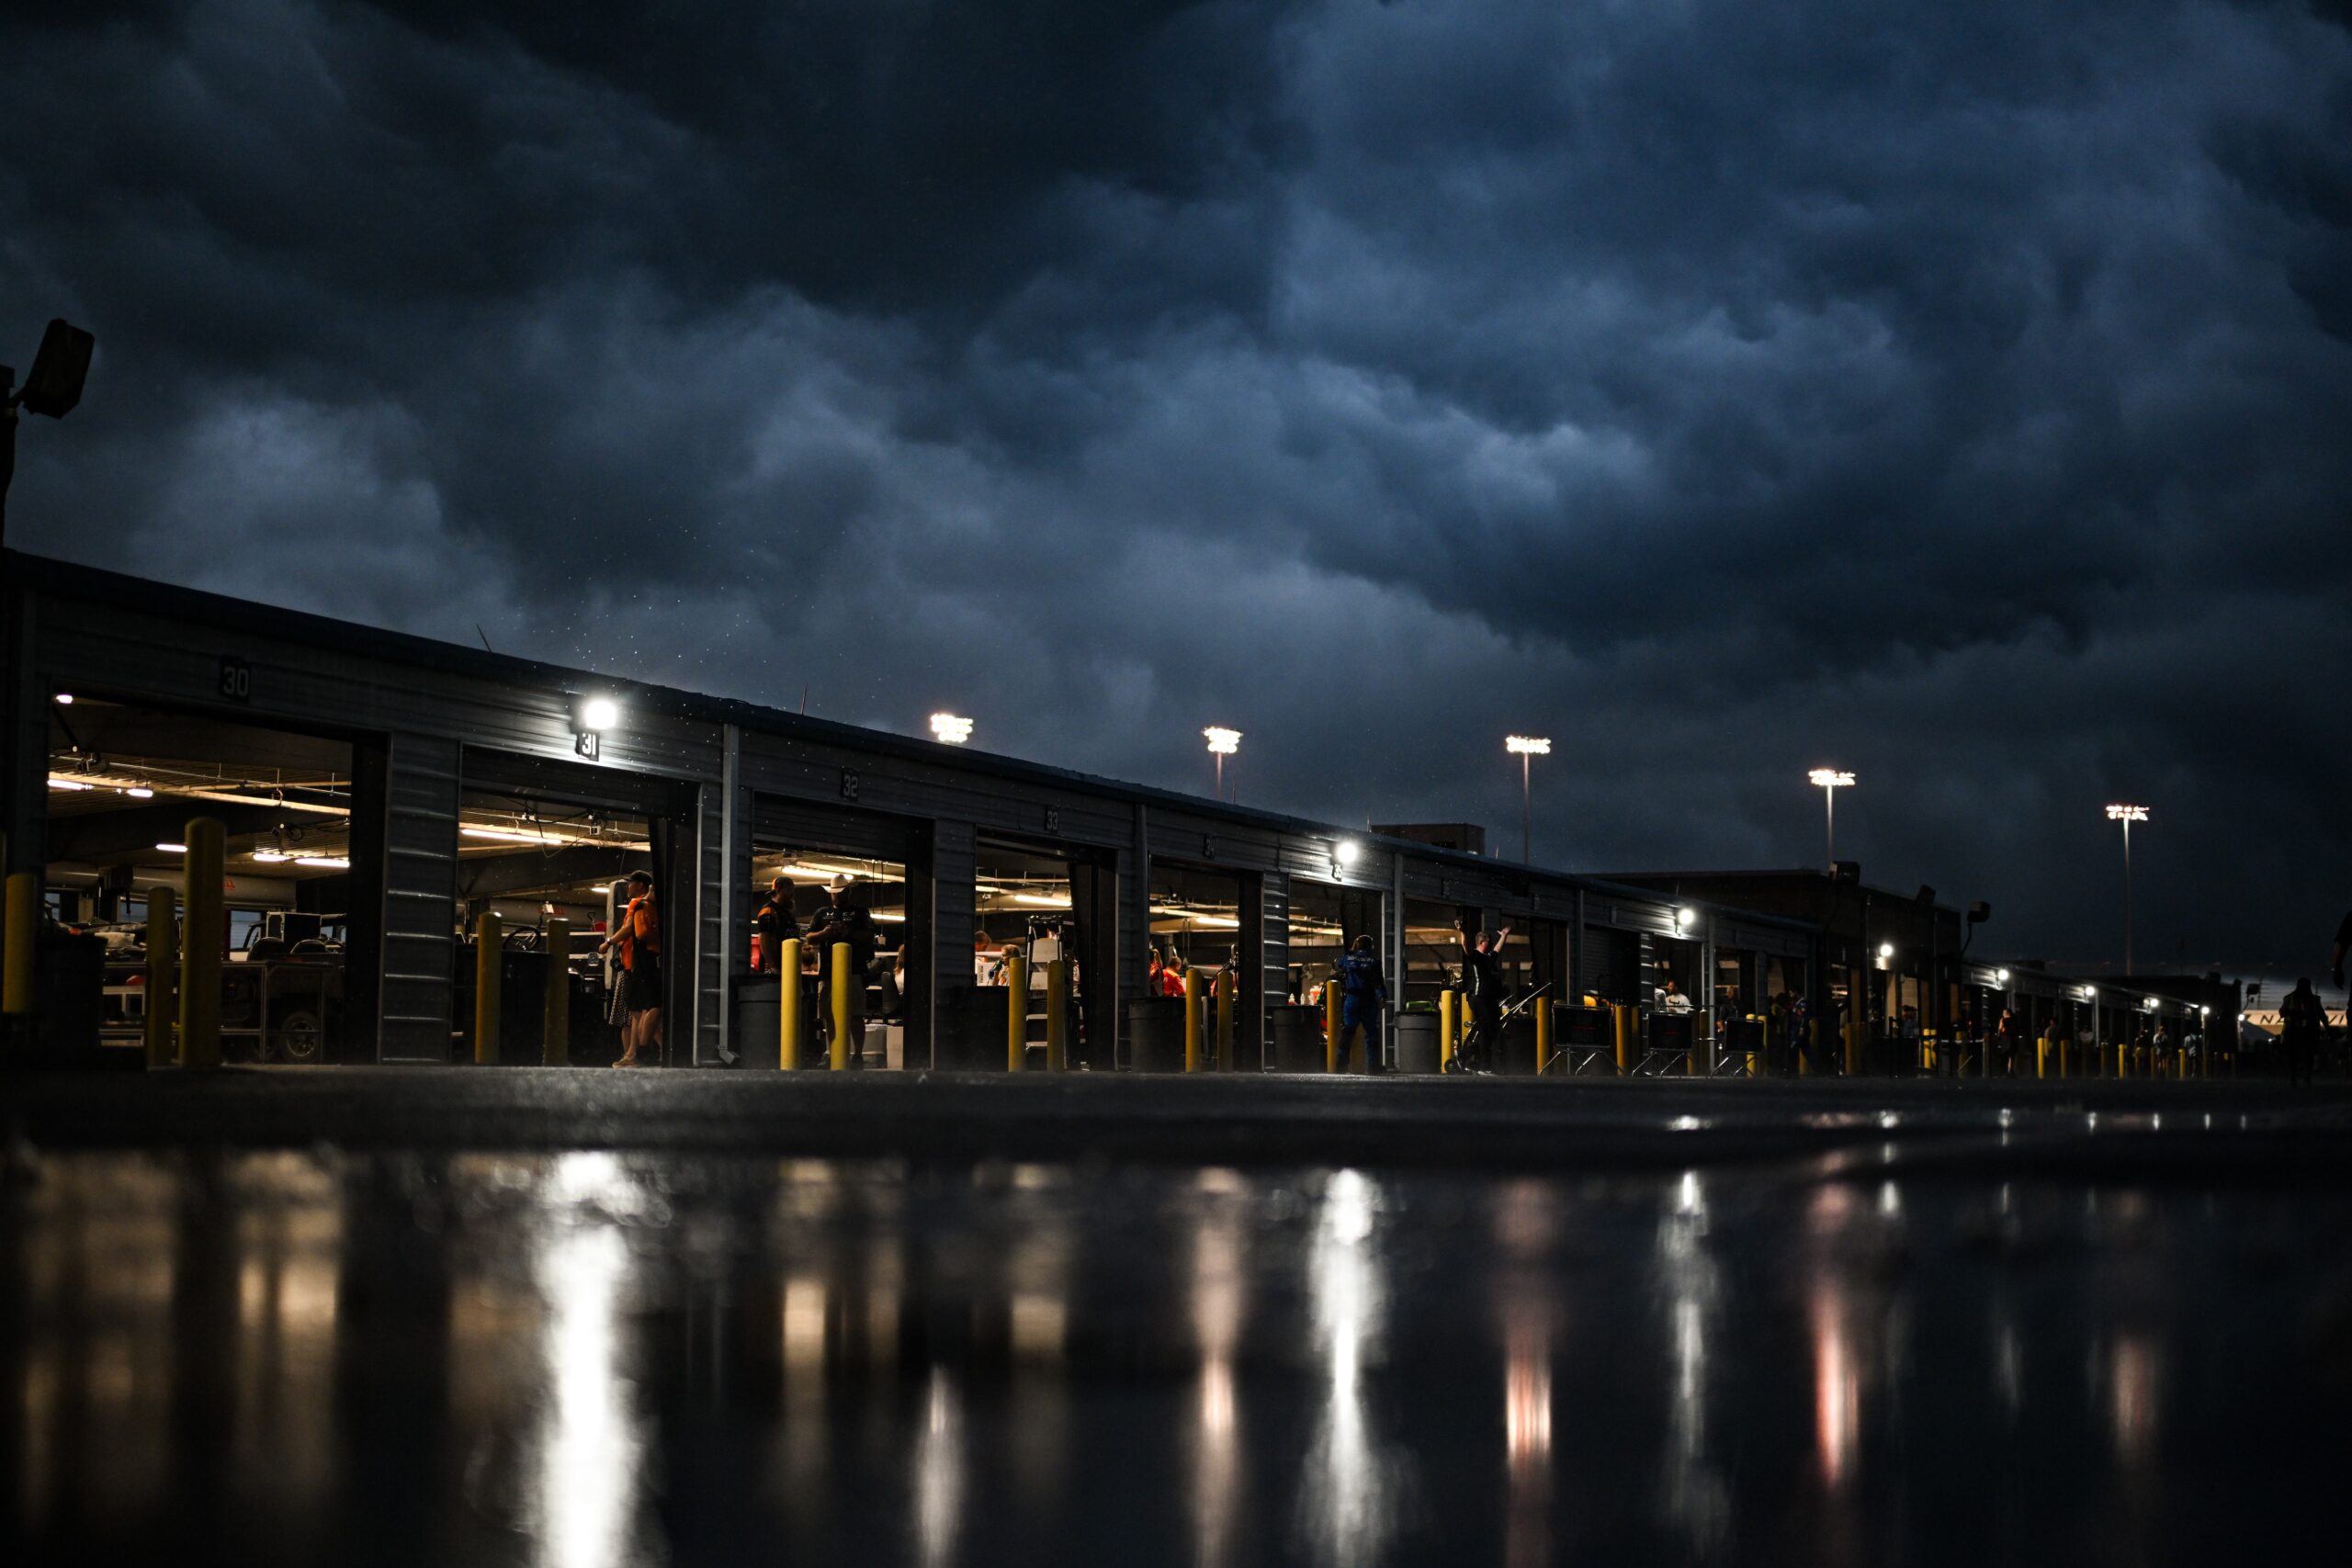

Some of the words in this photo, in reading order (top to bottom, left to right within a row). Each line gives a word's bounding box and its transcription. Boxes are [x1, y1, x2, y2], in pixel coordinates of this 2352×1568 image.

[223, 666, 249, 696] 30
[582, 733, 596, 755] 31
[843, 774, 857, 797] 32
[1047, 810, 1057, 830] 33
